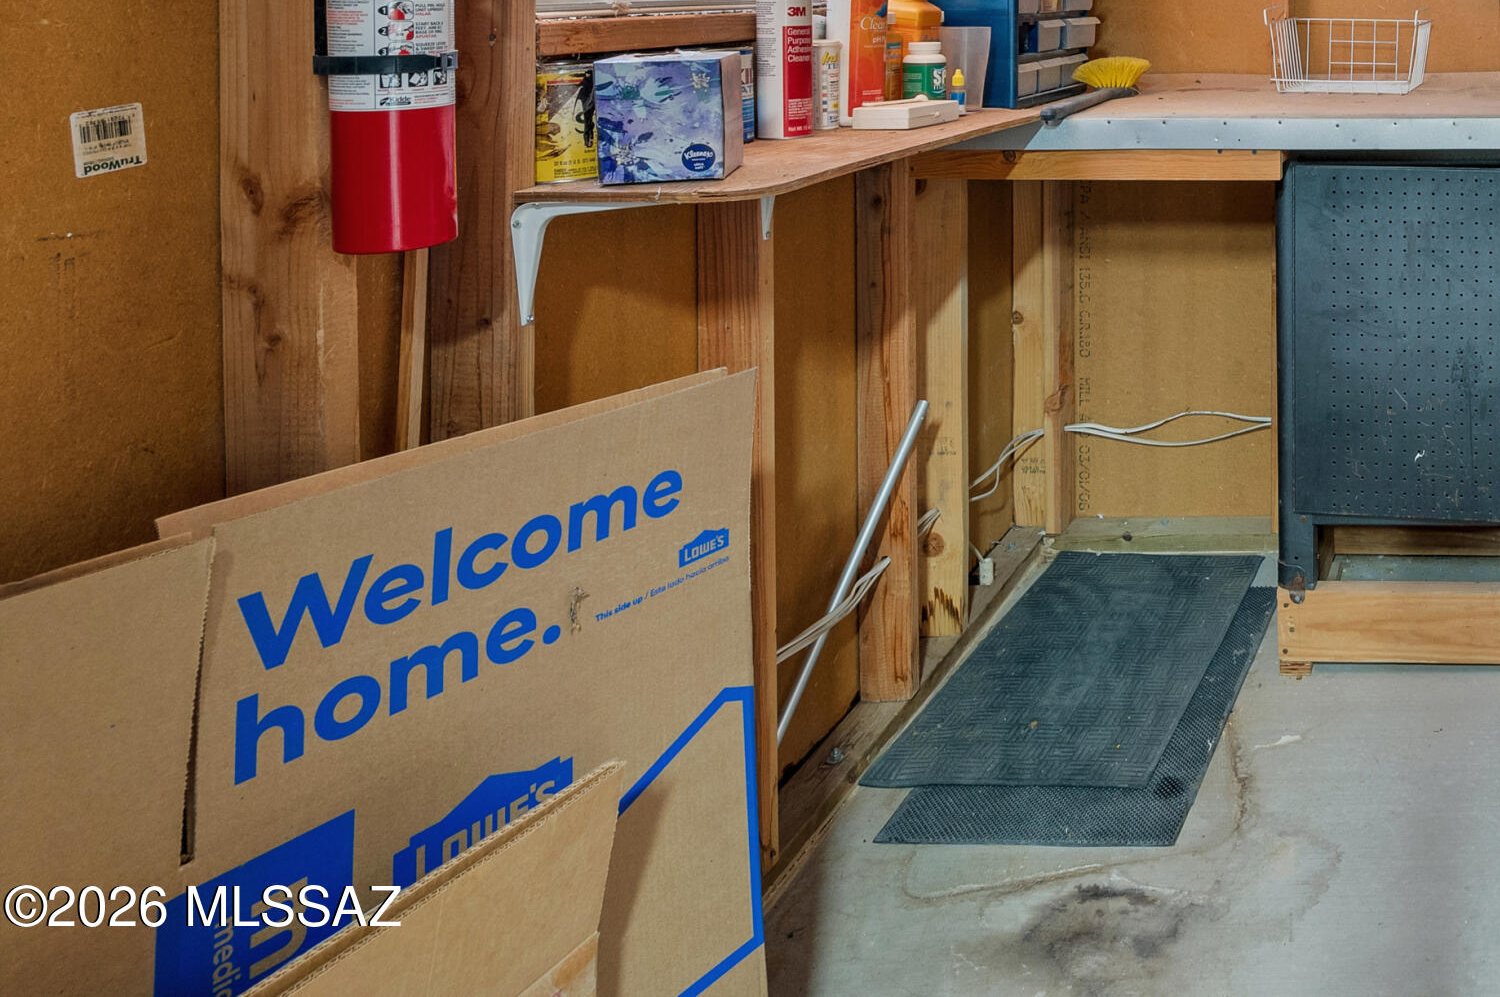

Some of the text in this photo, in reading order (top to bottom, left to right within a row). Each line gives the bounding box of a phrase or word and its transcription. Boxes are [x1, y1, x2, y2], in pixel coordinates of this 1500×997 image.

[787, 6, 806, 17] 3M
[84, 156, 143, 175] TruWood
[684, 535, 724, 562] LOWE'S
[237, 469, 683, 670] Welcome
[595, 611, 613, 622] This
[614, 602, 631, 614] side
[632, 596, 643, 606] up
[234, 607, 561, 786] home.
